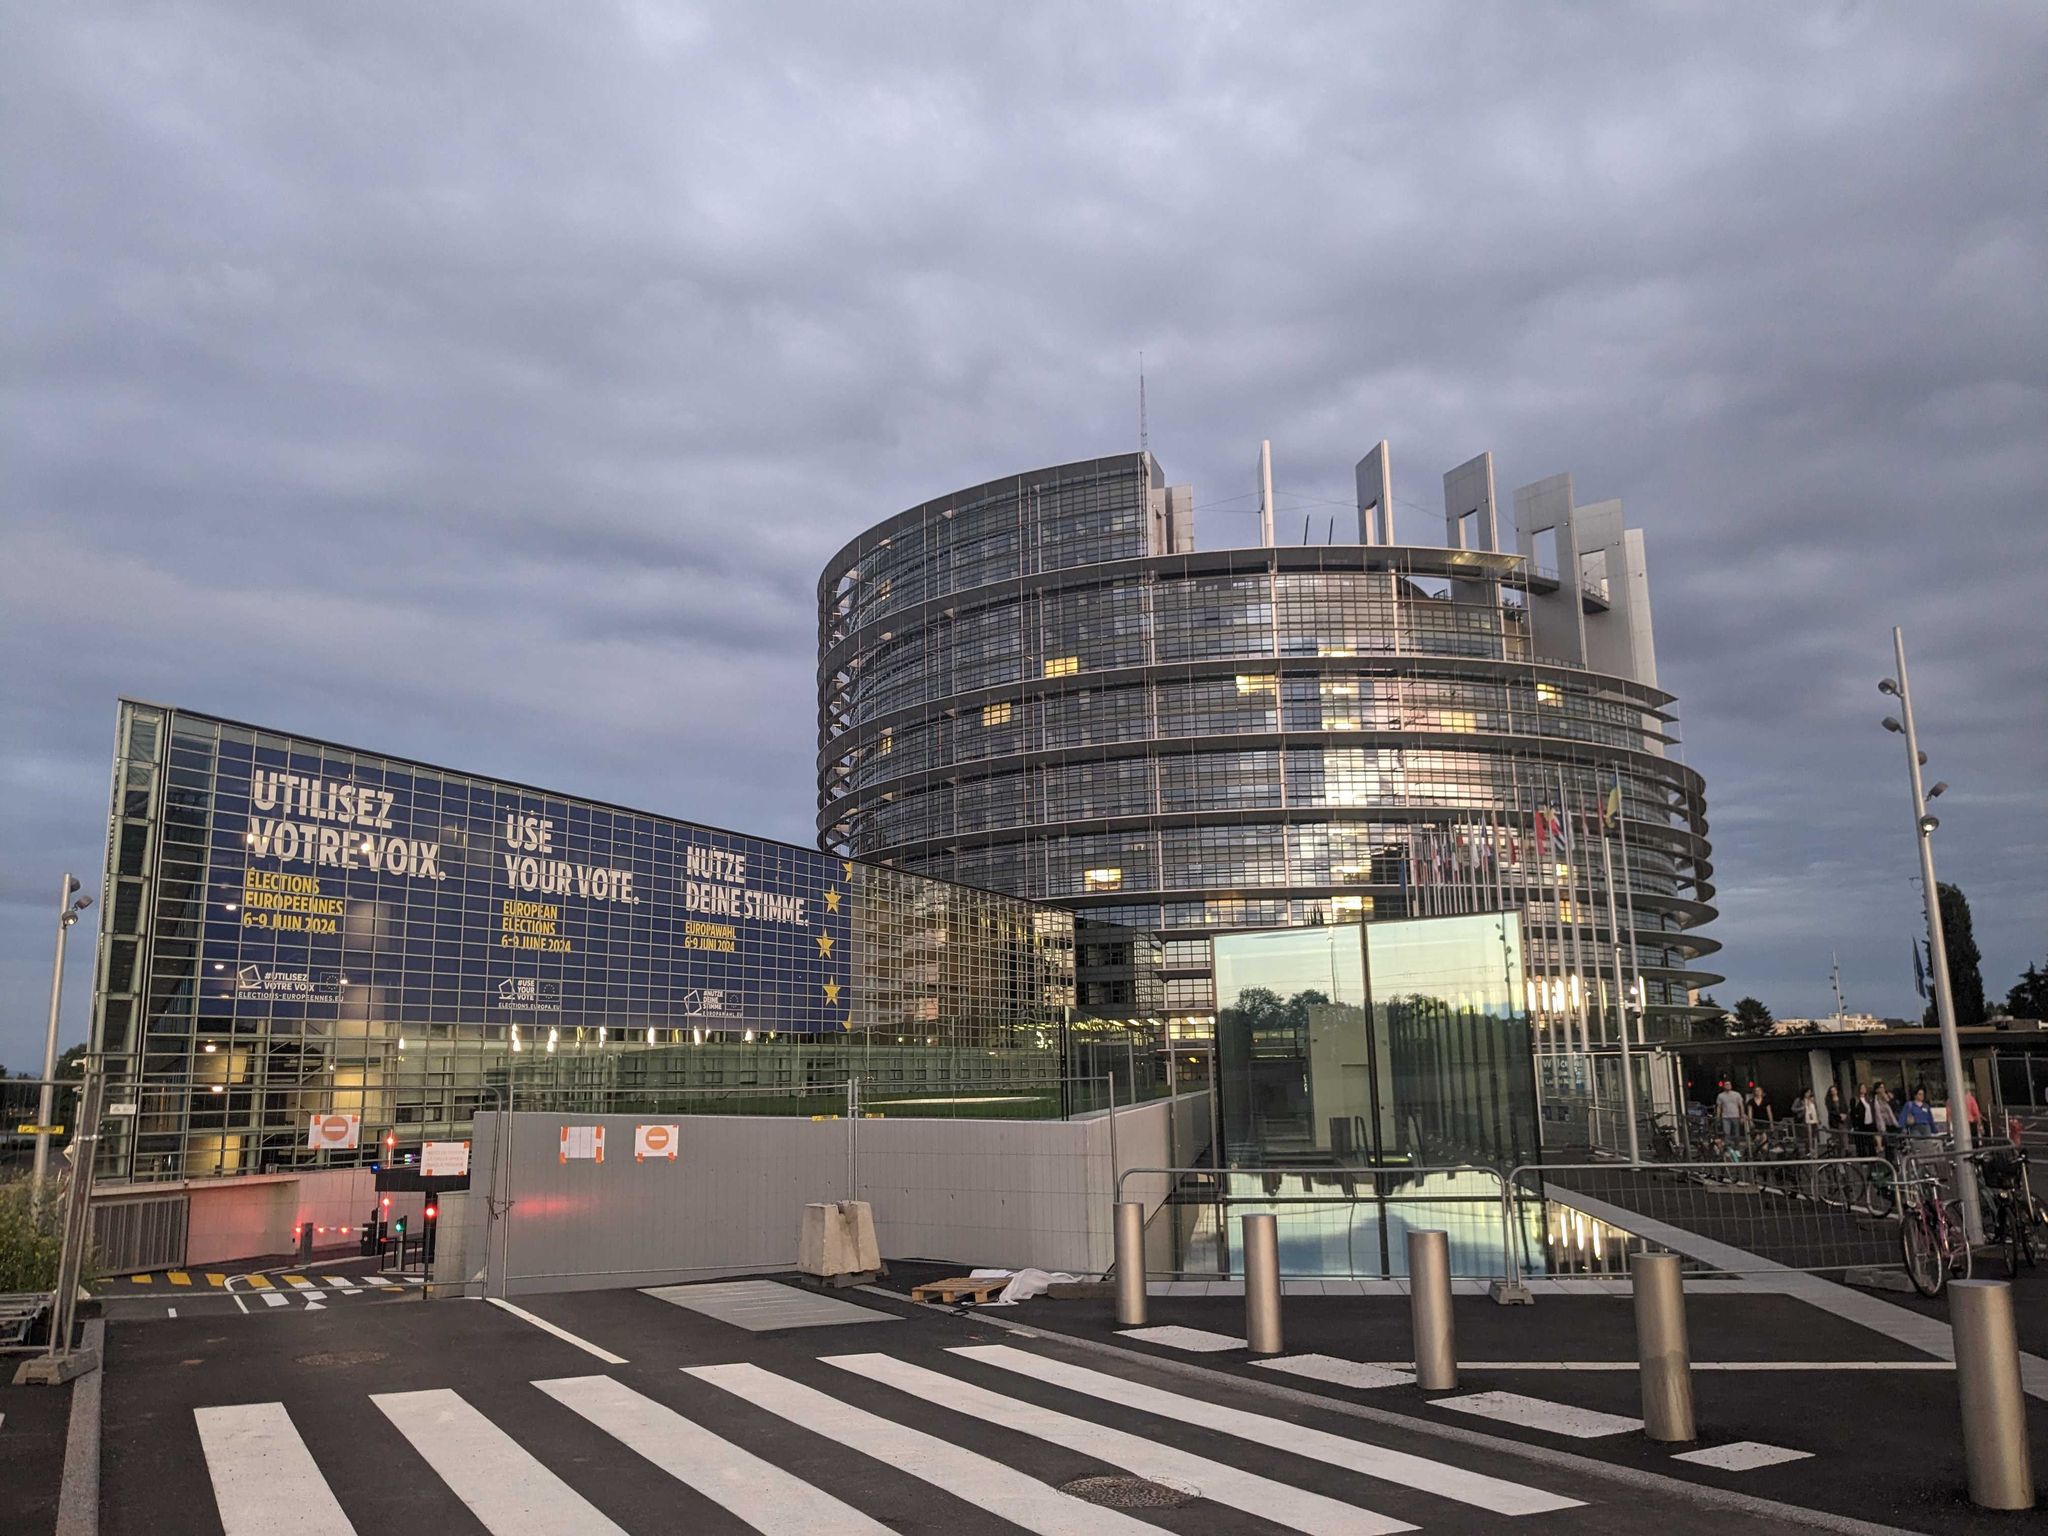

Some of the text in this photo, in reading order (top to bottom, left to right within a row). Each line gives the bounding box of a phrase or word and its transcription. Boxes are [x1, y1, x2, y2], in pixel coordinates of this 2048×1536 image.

[254, 769, 394, 829] UTILISEZ
[506, 814, 553, 853] USE
[251, 817, 446, 881] VOTRE VOIX.
[686, 845, 745, 883] NUTZE
[246, 866, 320, 894] ÉLECTIONS
[504, 854, 640, 905] YOUR VOTE.
[503, 900, 558, 920] EUROPEAN
[685, 880, 809, 927] DEINE STIMME.
[243, 911, 336, 935] 6-9 JUIN 2024
[502, 917, 556, 935] ELECTIONS
[685, 921, 737, 939] EUROPAWAHL
[501, 934, 571, 953] 6-9 JUNE 2024
[684, 937, 735, 952] 6-9 JUNI 2024
[264, 971, 308, 981] #UTILISEZ
[518, 979, 535, 987] #USE
[264, 982, 315, 992] VOTRE VOX
[518, 986, 535, 994] YOUR
[517, 993, 535, 1001] VOTE
